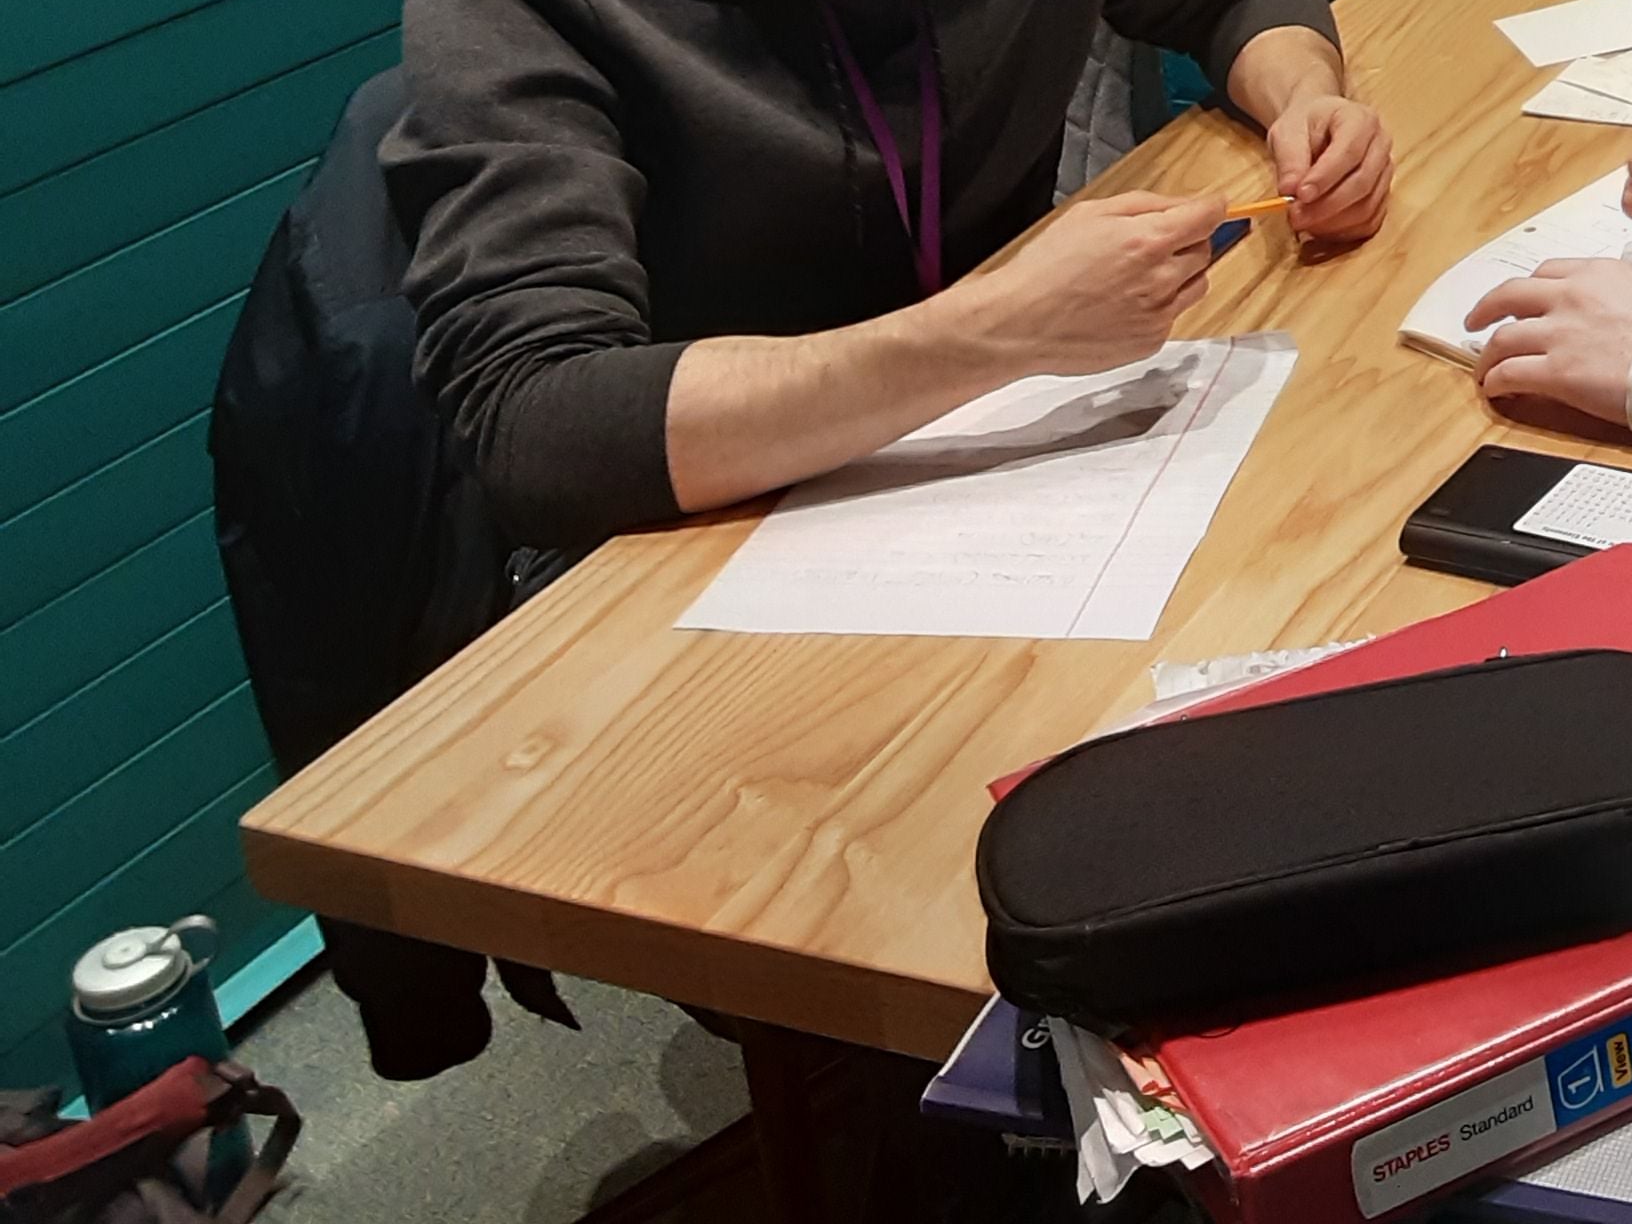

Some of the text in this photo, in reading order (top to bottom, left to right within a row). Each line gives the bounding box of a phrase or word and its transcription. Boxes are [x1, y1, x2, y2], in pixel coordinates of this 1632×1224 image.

[1613, 1041, 1629, 1081] View
[1372, 1096, 1534, 1182] STAPLES Standard
